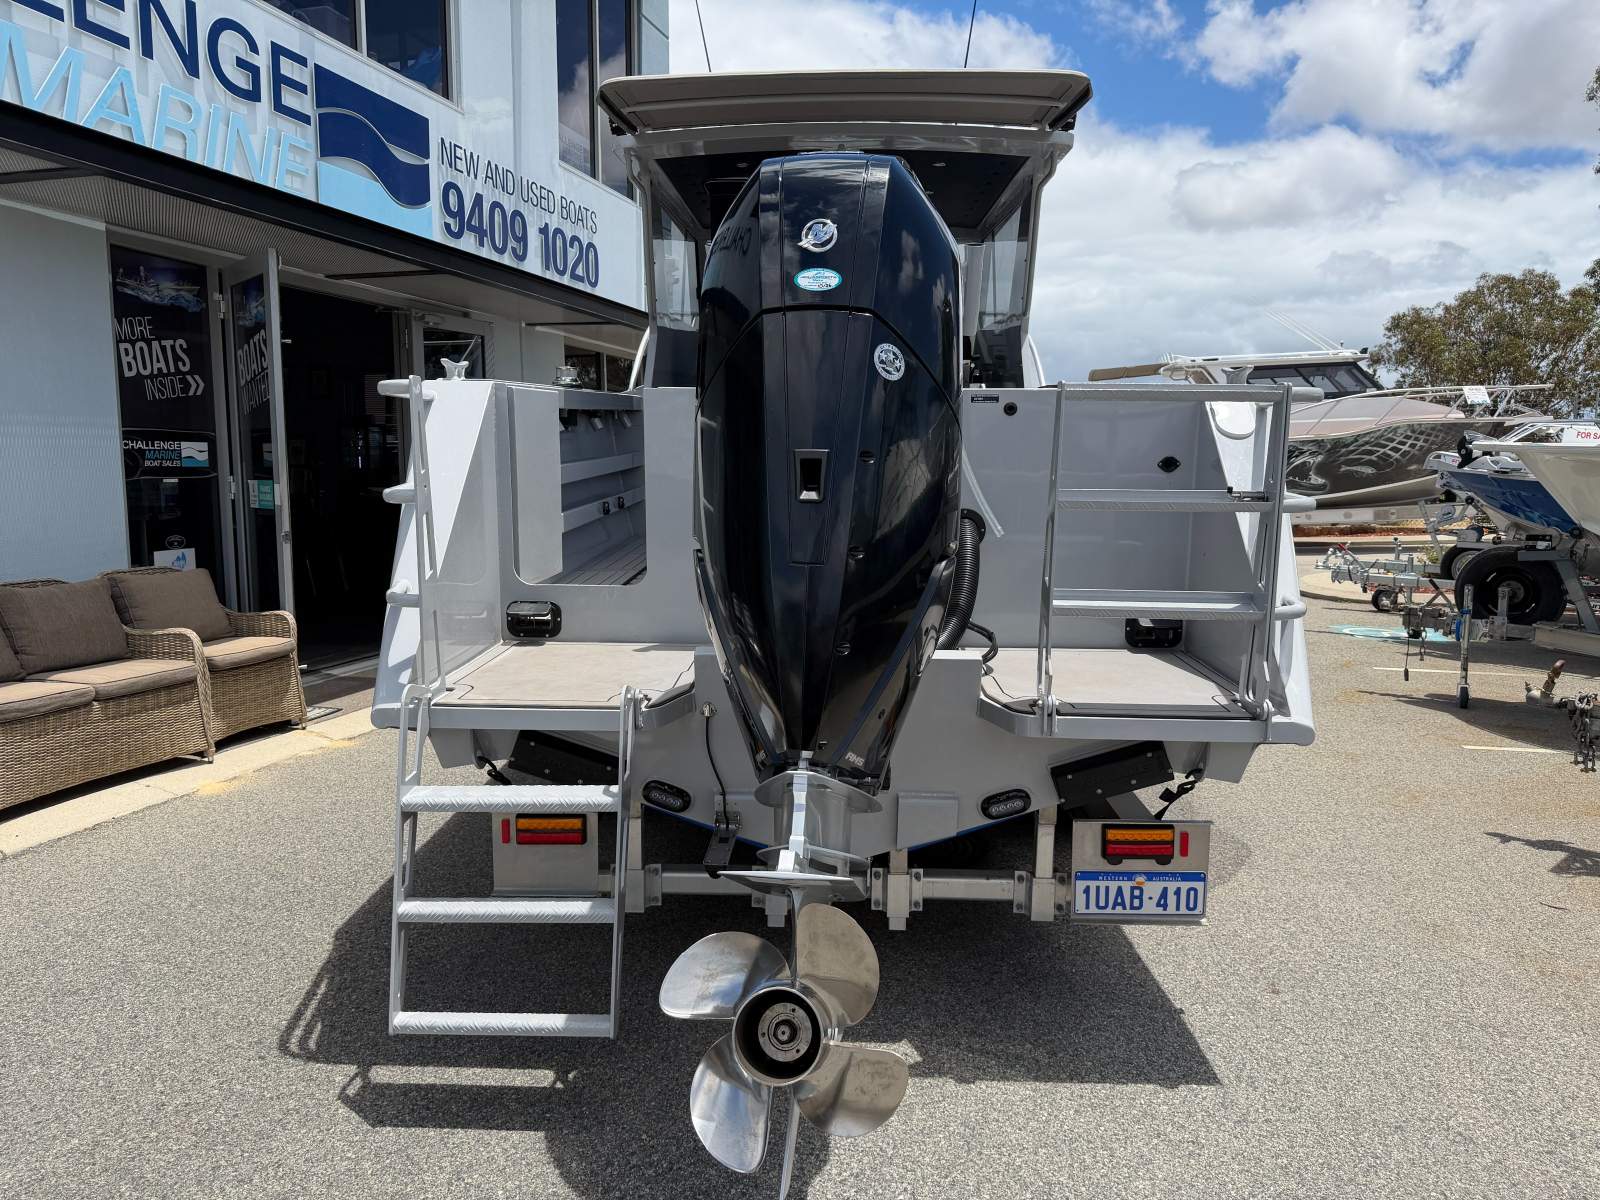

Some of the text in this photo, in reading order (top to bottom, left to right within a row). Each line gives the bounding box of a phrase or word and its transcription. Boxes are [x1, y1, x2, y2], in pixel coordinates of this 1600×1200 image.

[11, 0, 312, 127] ENGE
[0, 20, 314, 199] MARINE
[440, 136, 598, 234] NEW AND USED BOATS
[441, 180, 600, 289] 9409 1020
[113, 316, 155, 340] MORE
[118, 338, 191, 378] BOATS
[237, 328, 268, 387] BOATS
[144, 375, 186, 401] INSIDE
[122, 440, 182, 450] CHALLENGE
[145, 450, 181, 460] MARINE
